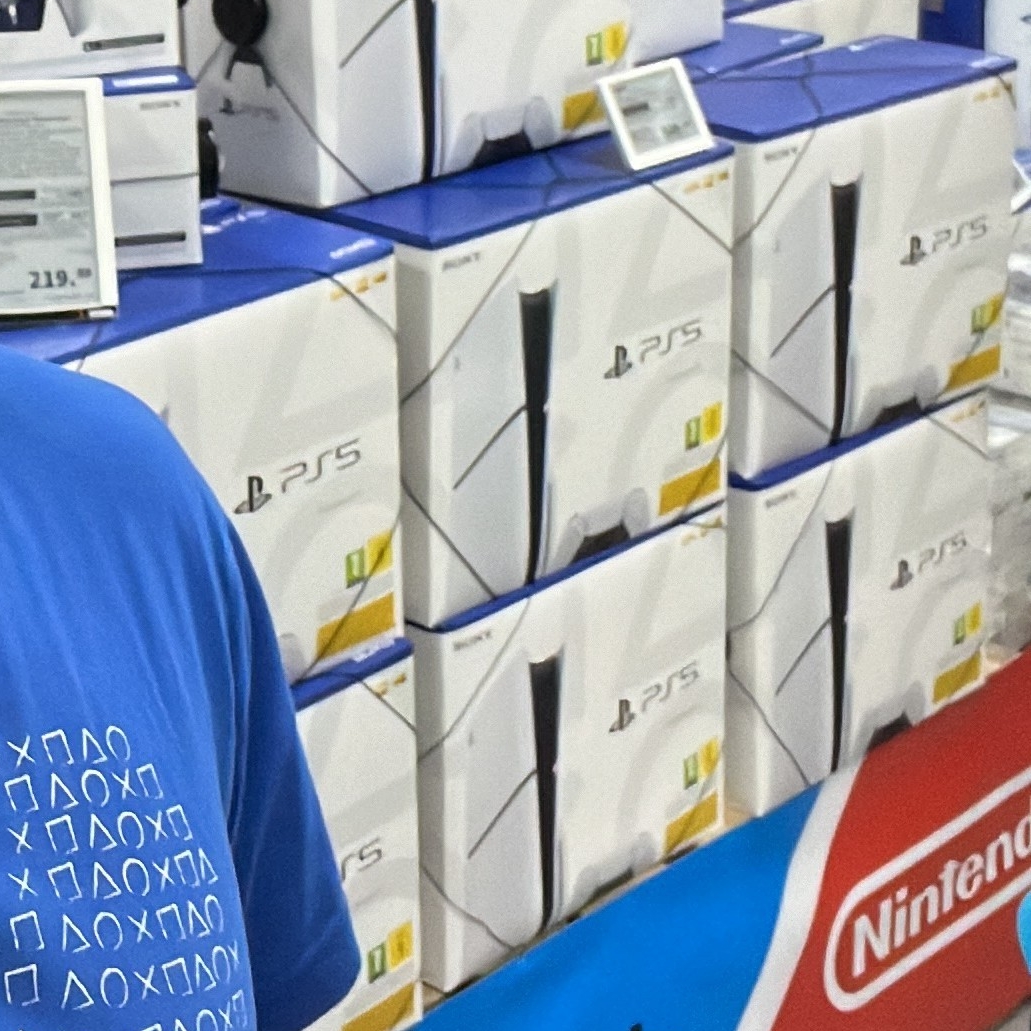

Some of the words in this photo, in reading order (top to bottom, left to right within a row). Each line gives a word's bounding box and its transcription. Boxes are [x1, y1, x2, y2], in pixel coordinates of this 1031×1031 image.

[931, 214, 988, 253] PS5
[639, 316, 702, 364] PS5
[279, 437, 362, 494] PS5
[640, 660, 700, 713] PS5
[340, 836, 383, 883] S5
